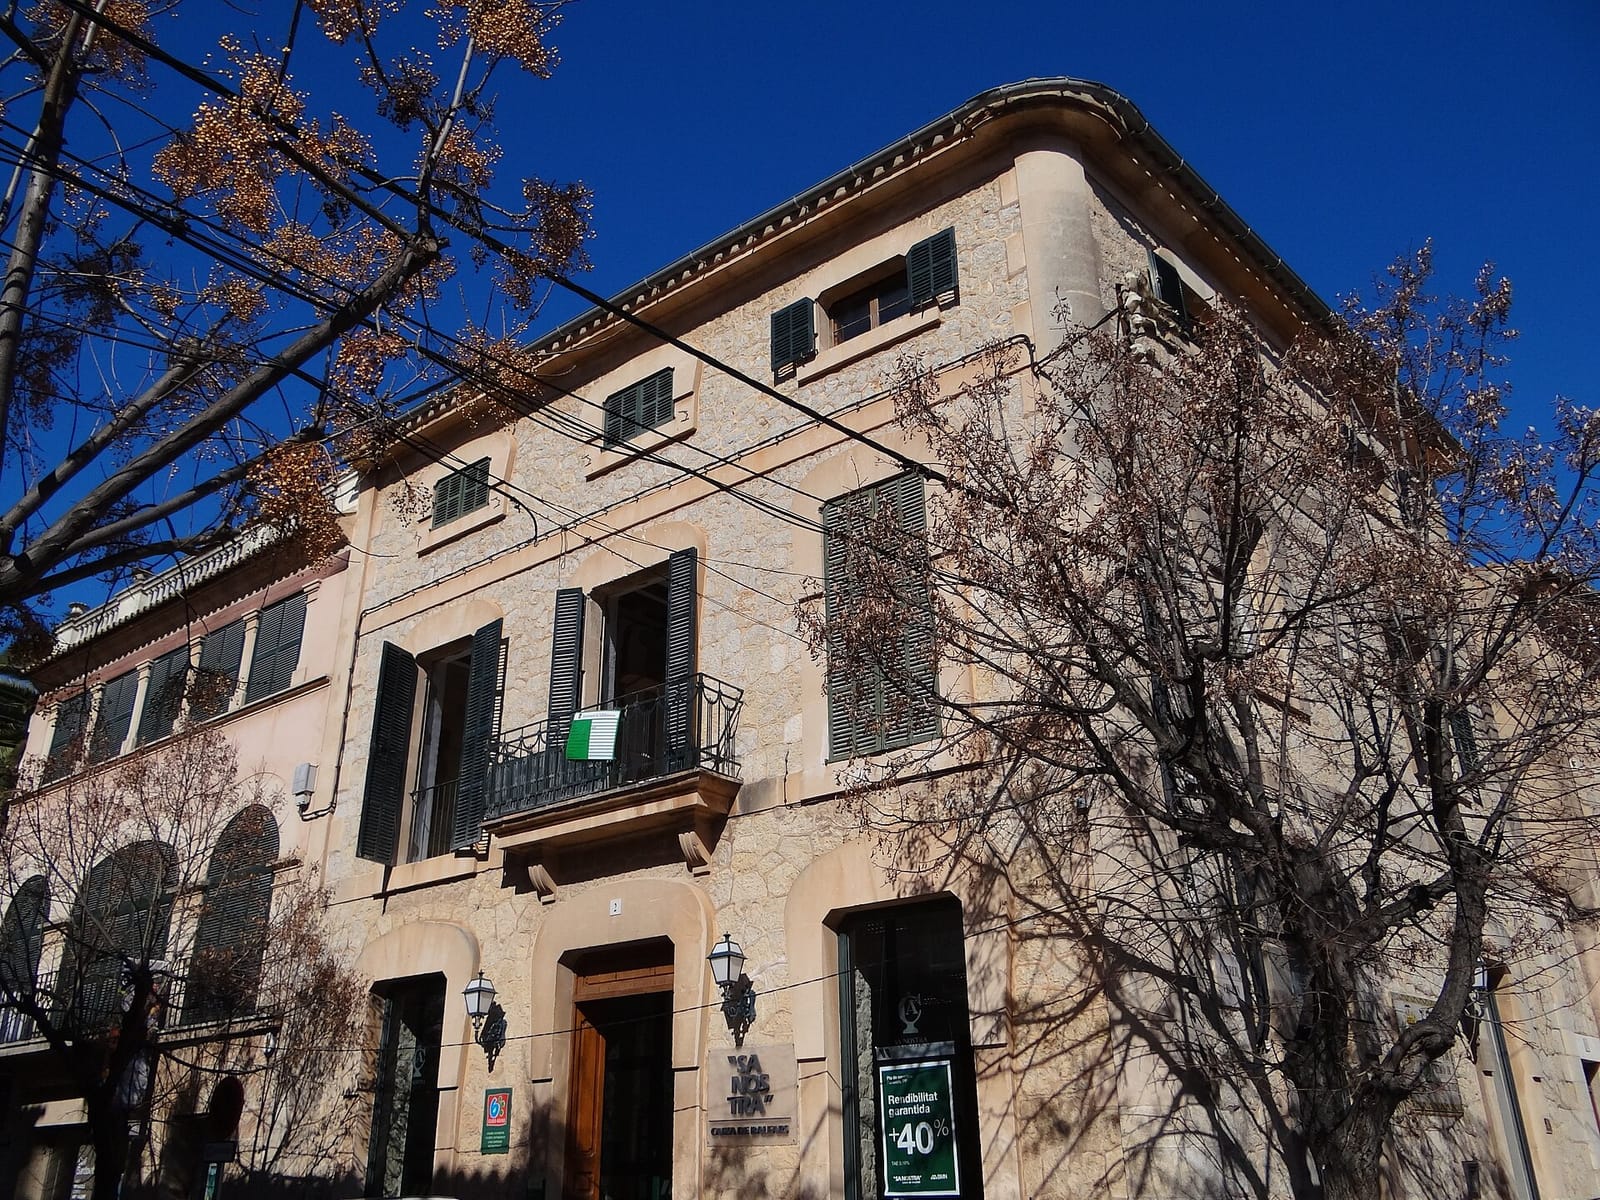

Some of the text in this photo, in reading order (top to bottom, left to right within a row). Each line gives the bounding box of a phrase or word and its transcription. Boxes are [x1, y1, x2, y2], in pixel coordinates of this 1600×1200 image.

[731, 1074, 770, 1094] NOS
[888, 1092, 938, 1105] Rendibilitat
[888, 1103, 931, 1118] garantida
